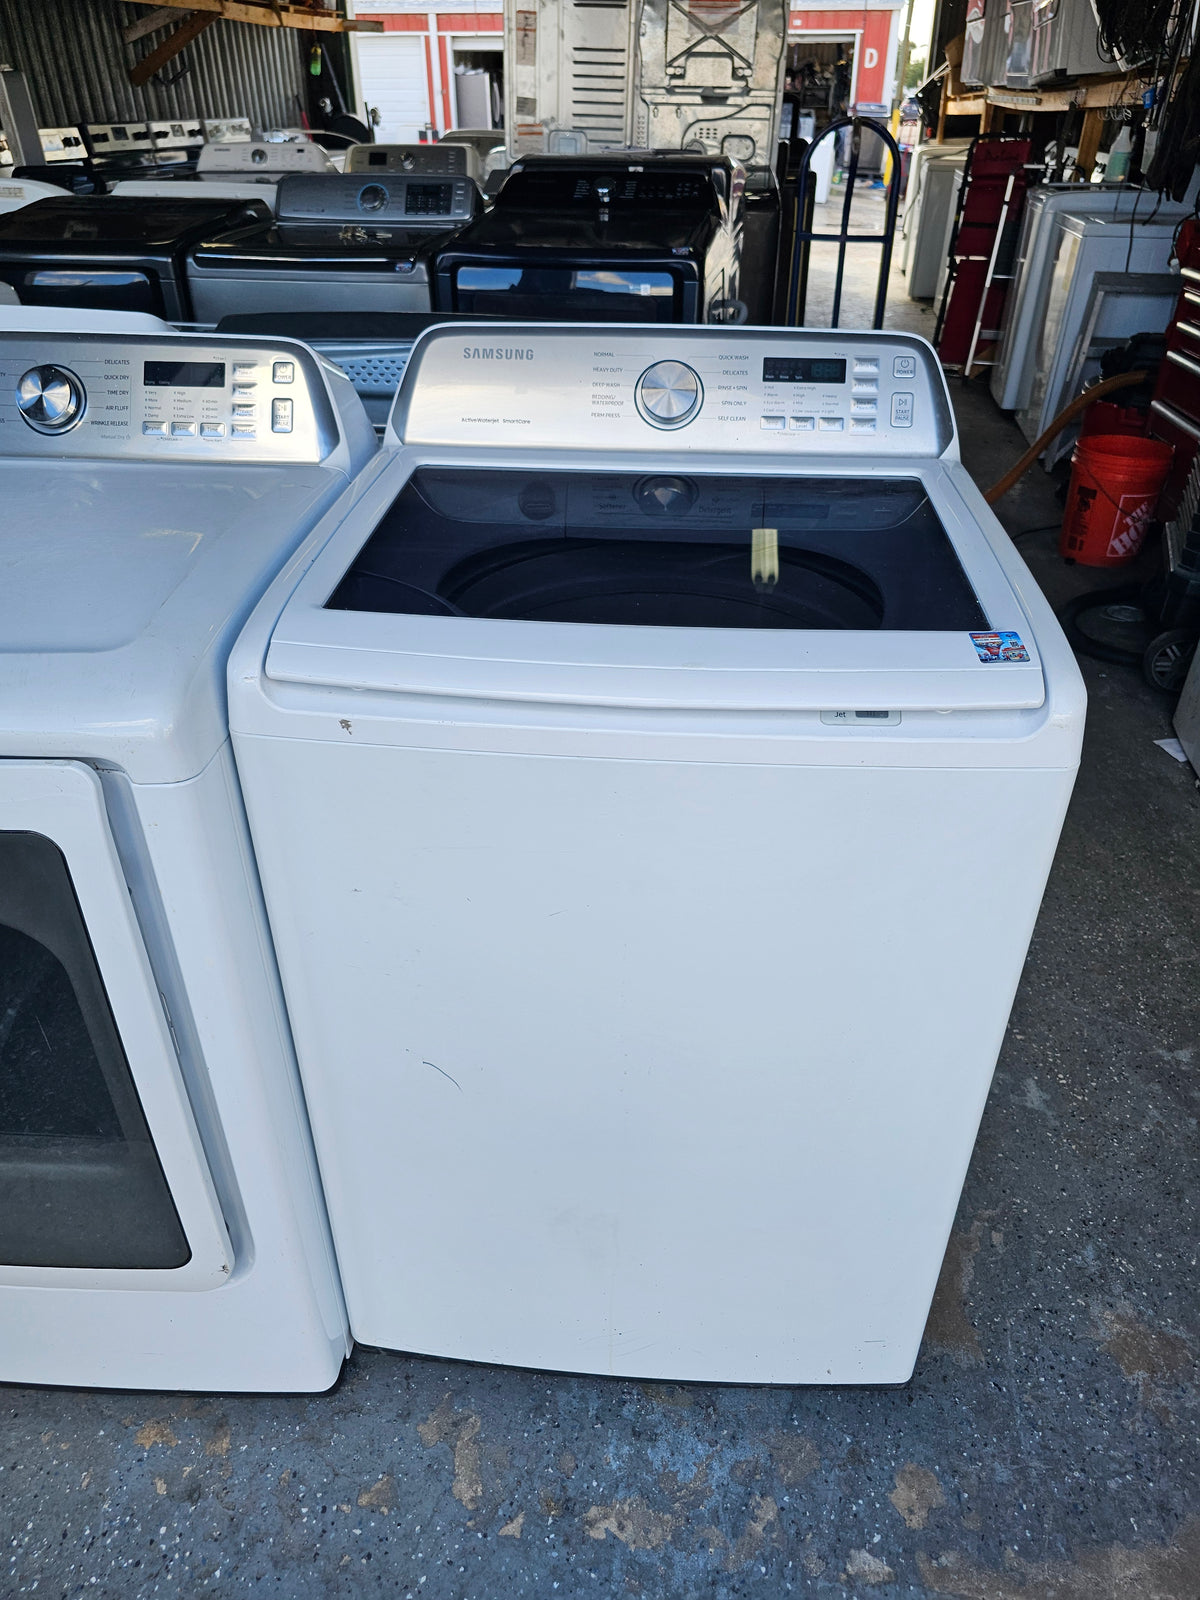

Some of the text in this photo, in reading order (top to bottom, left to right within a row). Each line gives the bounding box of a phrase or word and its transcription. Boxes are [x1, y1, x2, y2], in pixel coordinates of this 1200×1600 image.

[864, 48, 878, 68] D
[463, 347, 534, 361] SAMSUNG
[698, 505, 732, 515] Detergent
